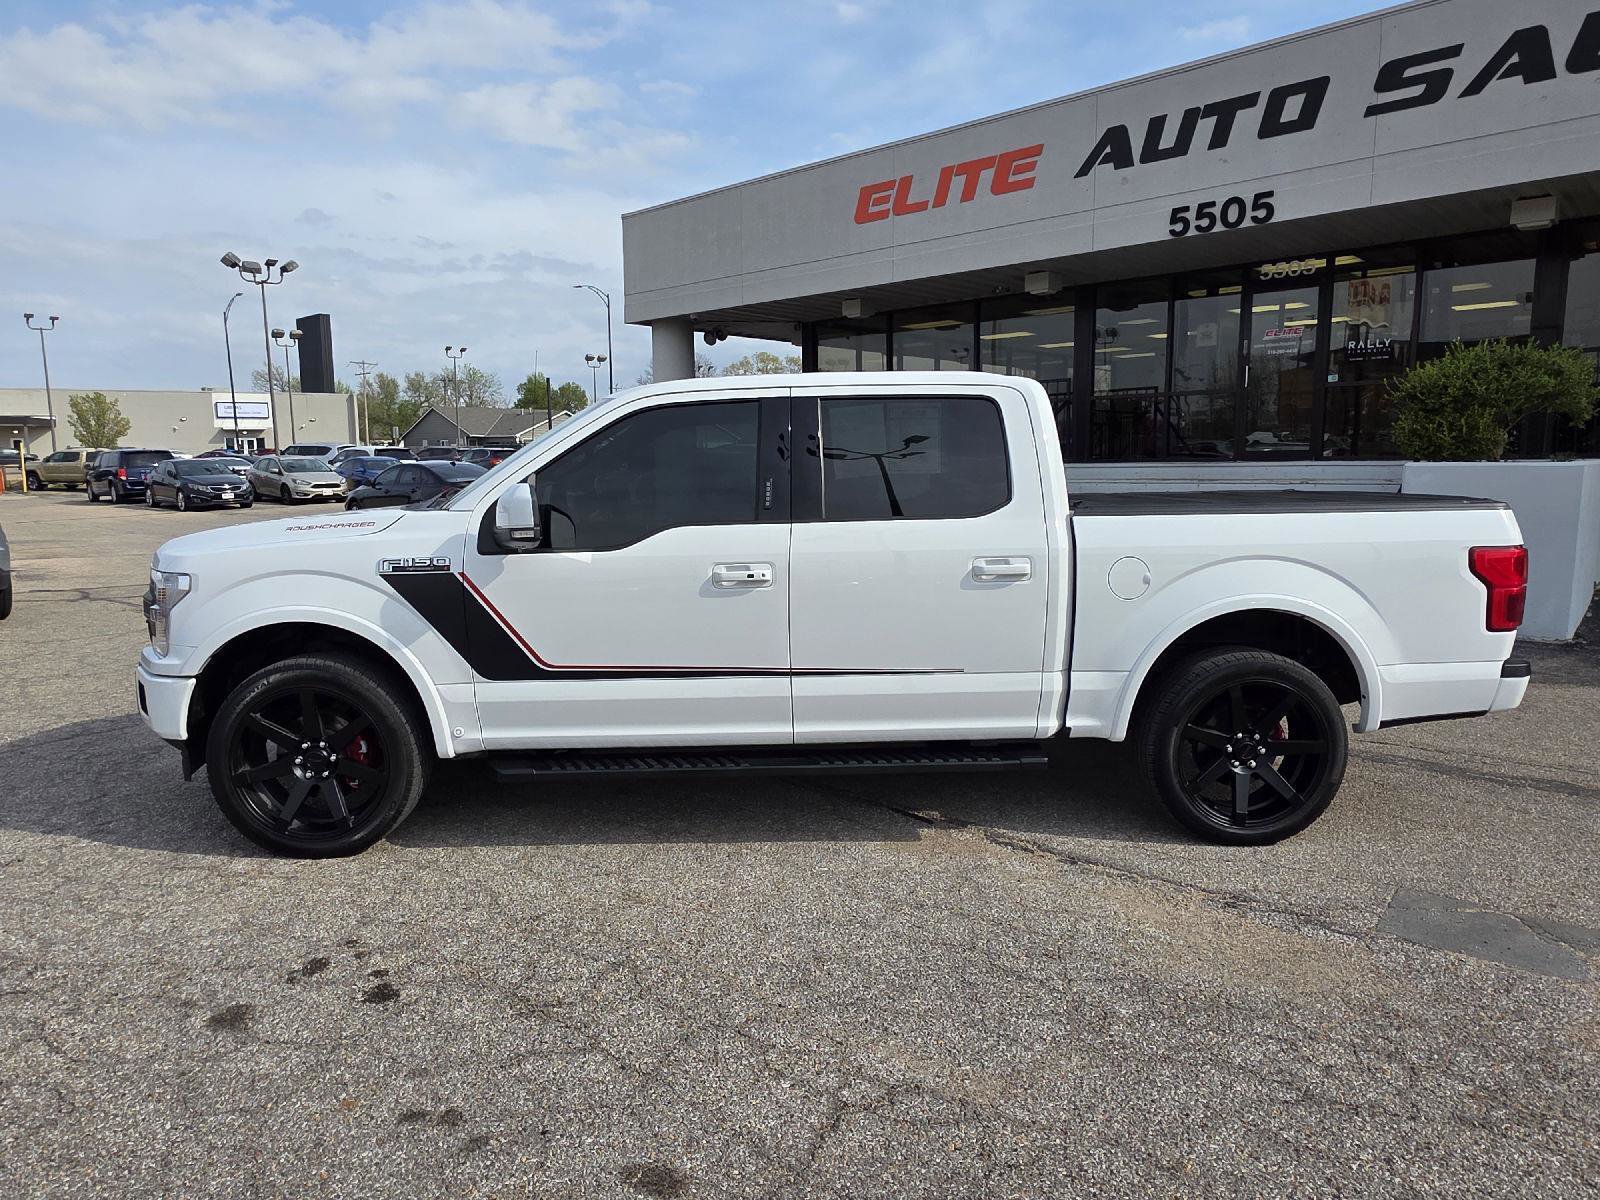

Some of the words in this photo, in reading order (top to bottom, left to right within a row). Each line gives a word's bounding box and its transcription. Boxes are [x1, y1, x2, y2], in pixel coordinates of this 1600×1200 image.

[852, 142, 1045, 225] ELITE
[1073, 74, 1331, 179] AUTO
[1168, 189, 1276, 238] 5505
[1260, 258, 1317, 281] 5505
[1264, 326, 1305, 338] ELITE
[1348, 338, 1392, 350] RALLY
[285, 521, 377, 532] ROUSHCHARGED
